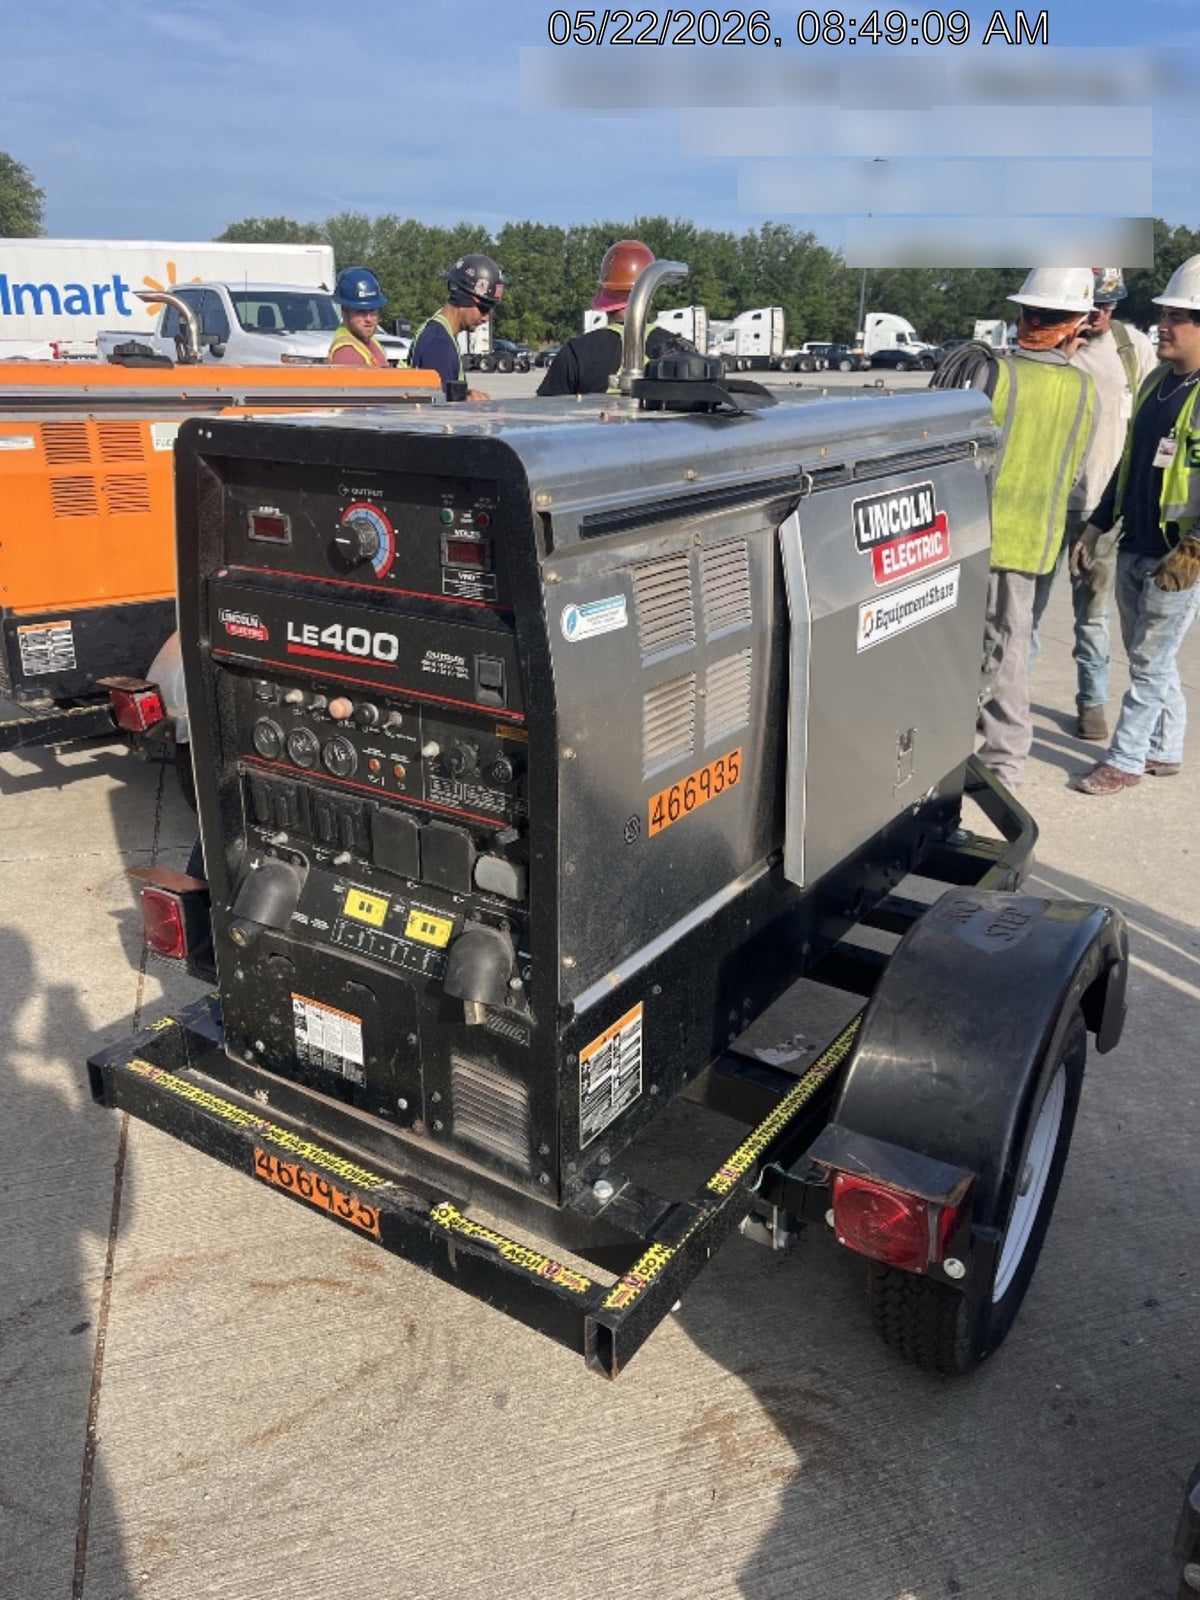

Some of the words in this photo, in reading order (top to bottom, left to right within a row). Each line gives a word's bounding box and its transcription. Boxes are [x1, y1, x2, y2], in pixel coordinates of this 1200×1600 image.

[858, 490, 933, 544] LINCOLN
[881, 531, 944, 575] ELECTRIC
[221, 611, 259, 628] LINCOLN
[875, 583, 954, 630] EquipmentShare
[287, 621, 399, 661] LE400
[651, 751, 738, 828] 466935
[257, 1154, 376, 1229] 466935
[639, 1258, 657, 1275] DO
